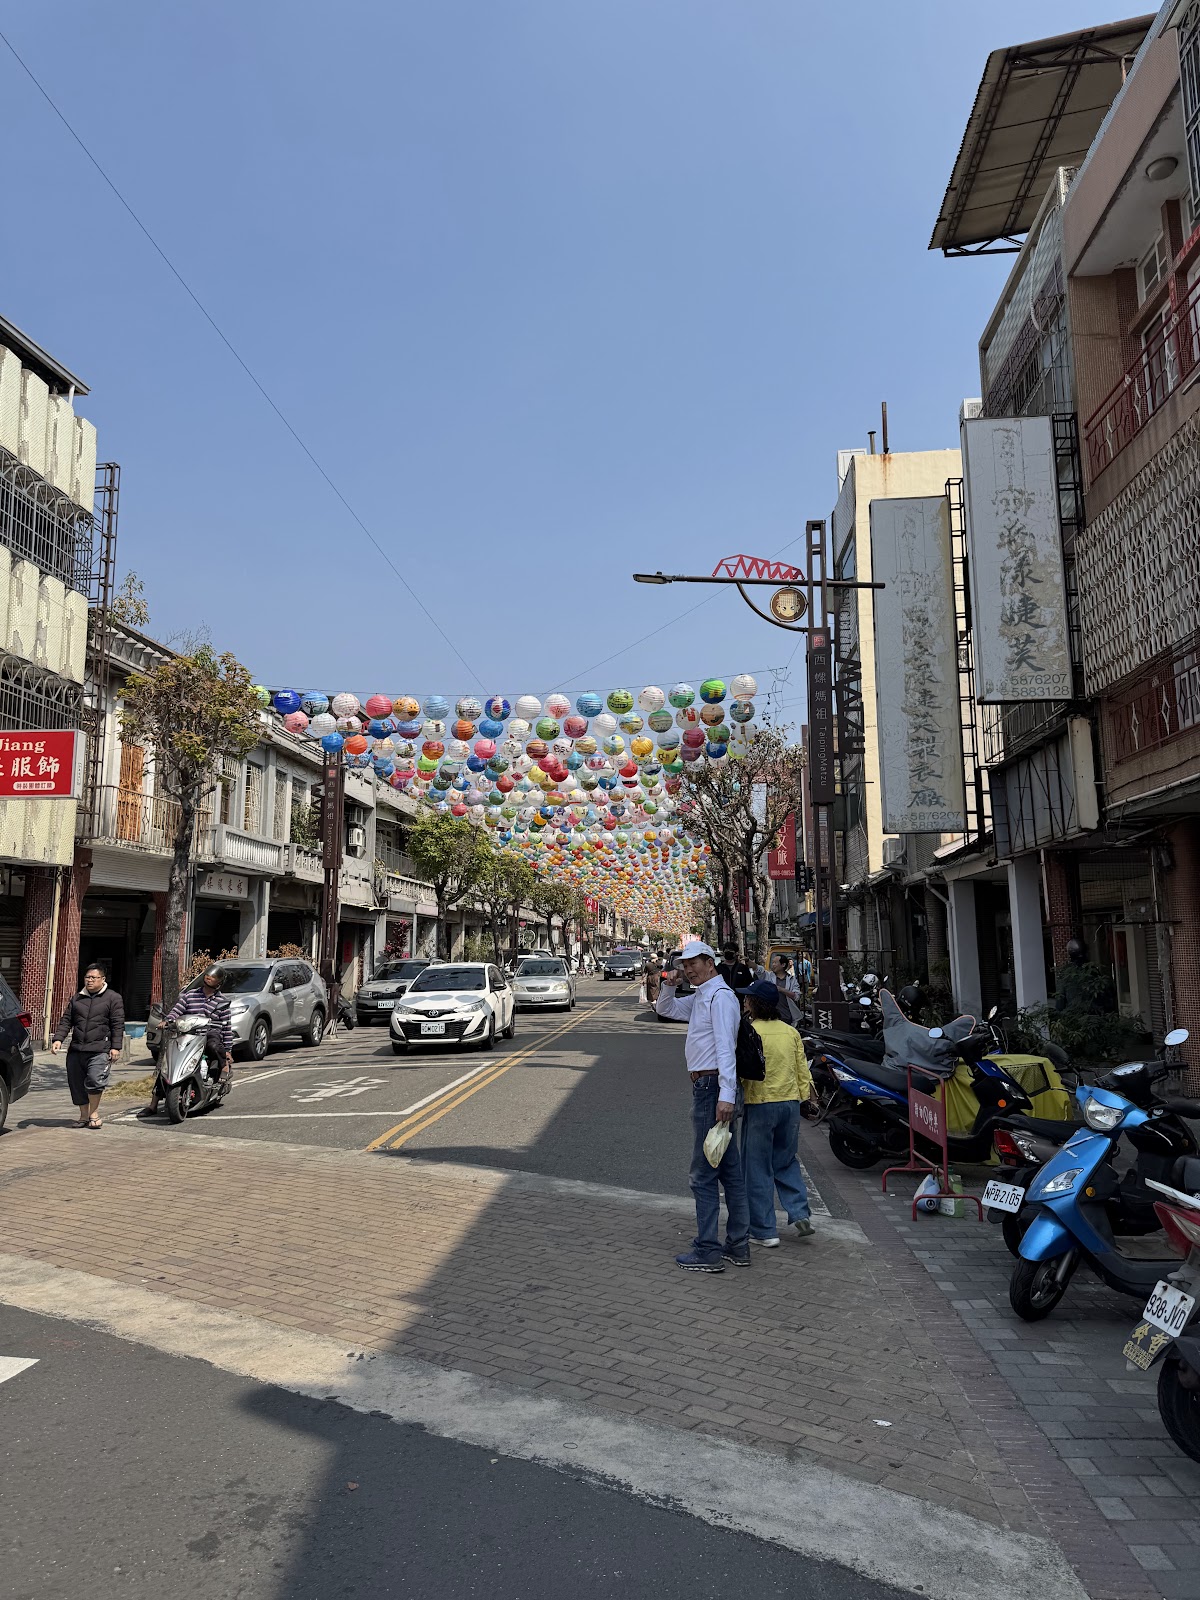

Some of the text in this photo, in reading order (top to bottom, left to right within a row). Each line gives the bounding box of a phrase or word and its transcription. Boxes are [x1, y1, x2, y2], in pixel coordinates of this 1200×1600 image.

[1010, 673, 1068, 686] 5876207
[813, 654, 828, 720] 西螺媽祖
[1010, 685, 1070, 698] 5883128
[910, 811, 961, 822] 5876207
